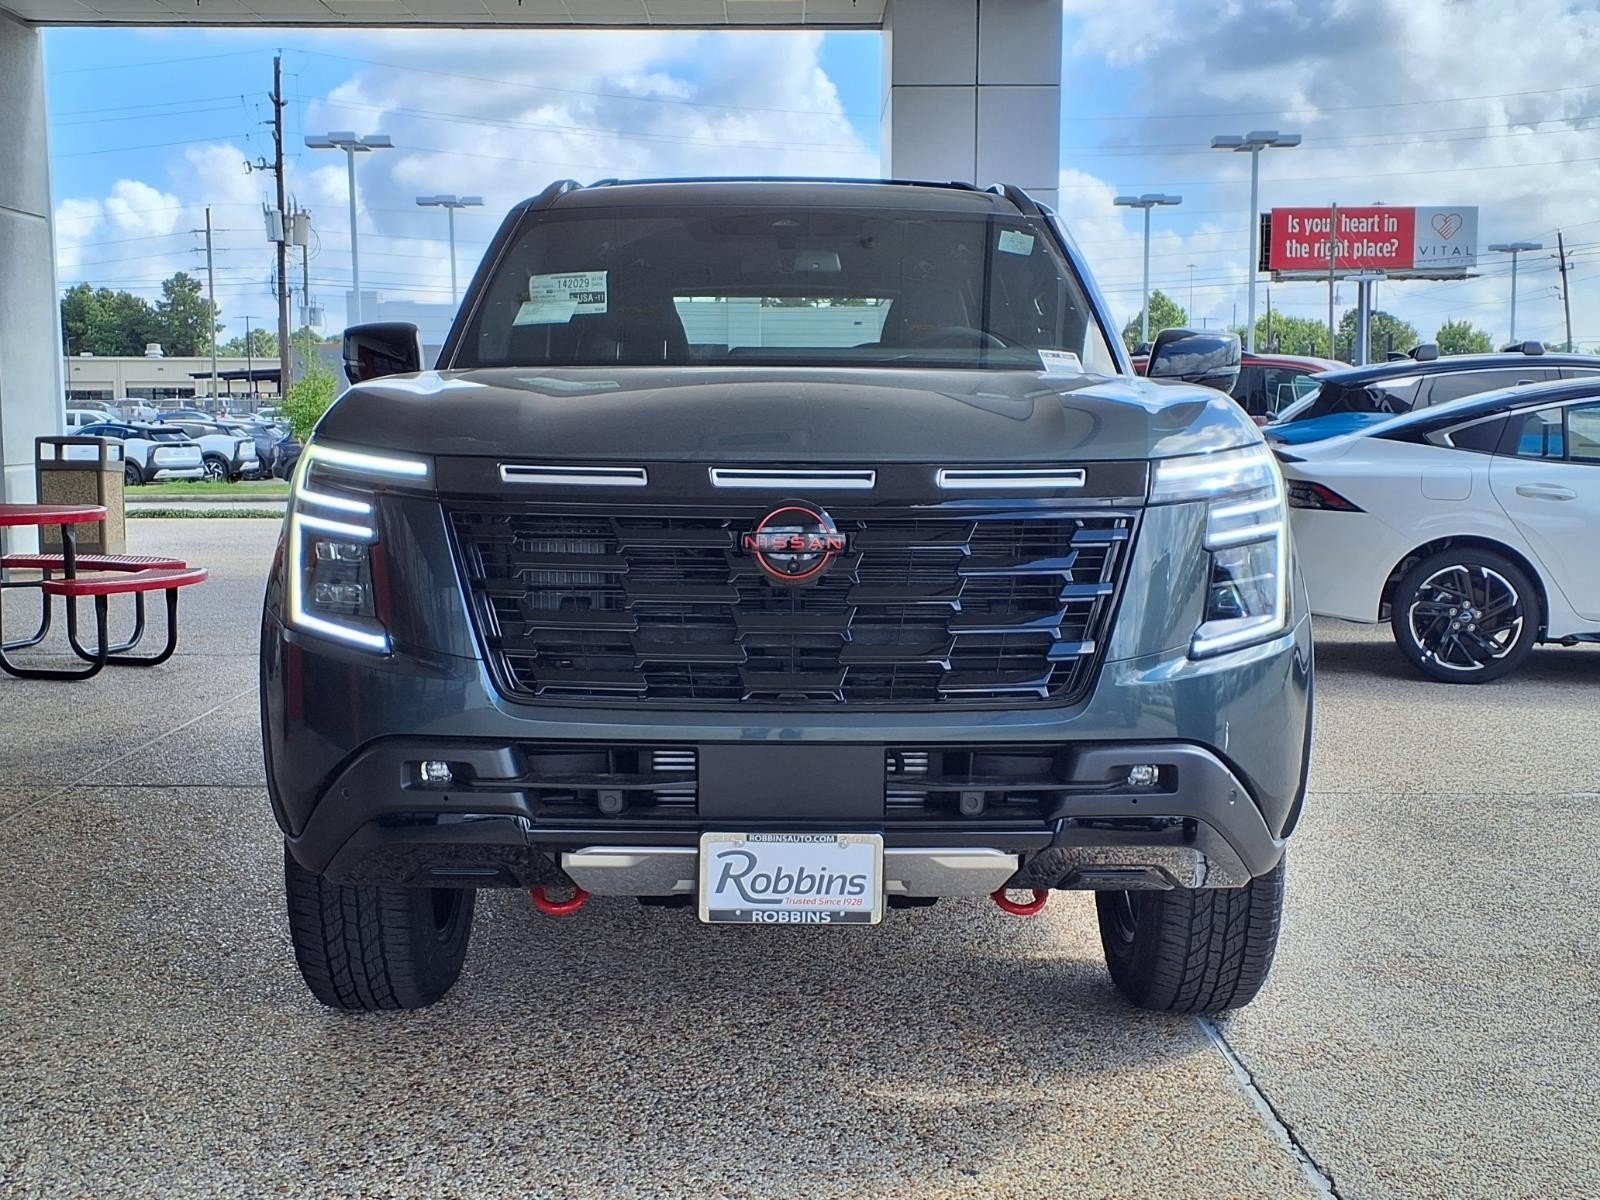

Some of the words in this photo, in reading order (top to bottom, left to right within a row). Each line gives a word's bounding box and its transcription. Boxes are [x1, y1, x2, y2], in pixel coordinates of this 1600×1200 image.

[1287, 214, 1299, 233] Is
[1304, 217, 1337, 236] you
[1341, 214, 1379, 232] heart
[1384, 214, 1397, 232] in
[1285, 239, 1309, 258] the
[1353, 238, 1399, 260] place?
[1419, 246, 1473, 256] VITAL
[557, 279, 590, 289] 142029
[744, 536, 842, 549] NISSAN
[749, 834, 835, 843] ROBBINSAUTO.COM
[715, 850, 868, 905] Robbins
[785, 897, 817, 905] Trusted
[818, 897, 842, 906] Since
[842, 897, 863, 907] 1928
[752, 910, 832, 923] ROBBINS
